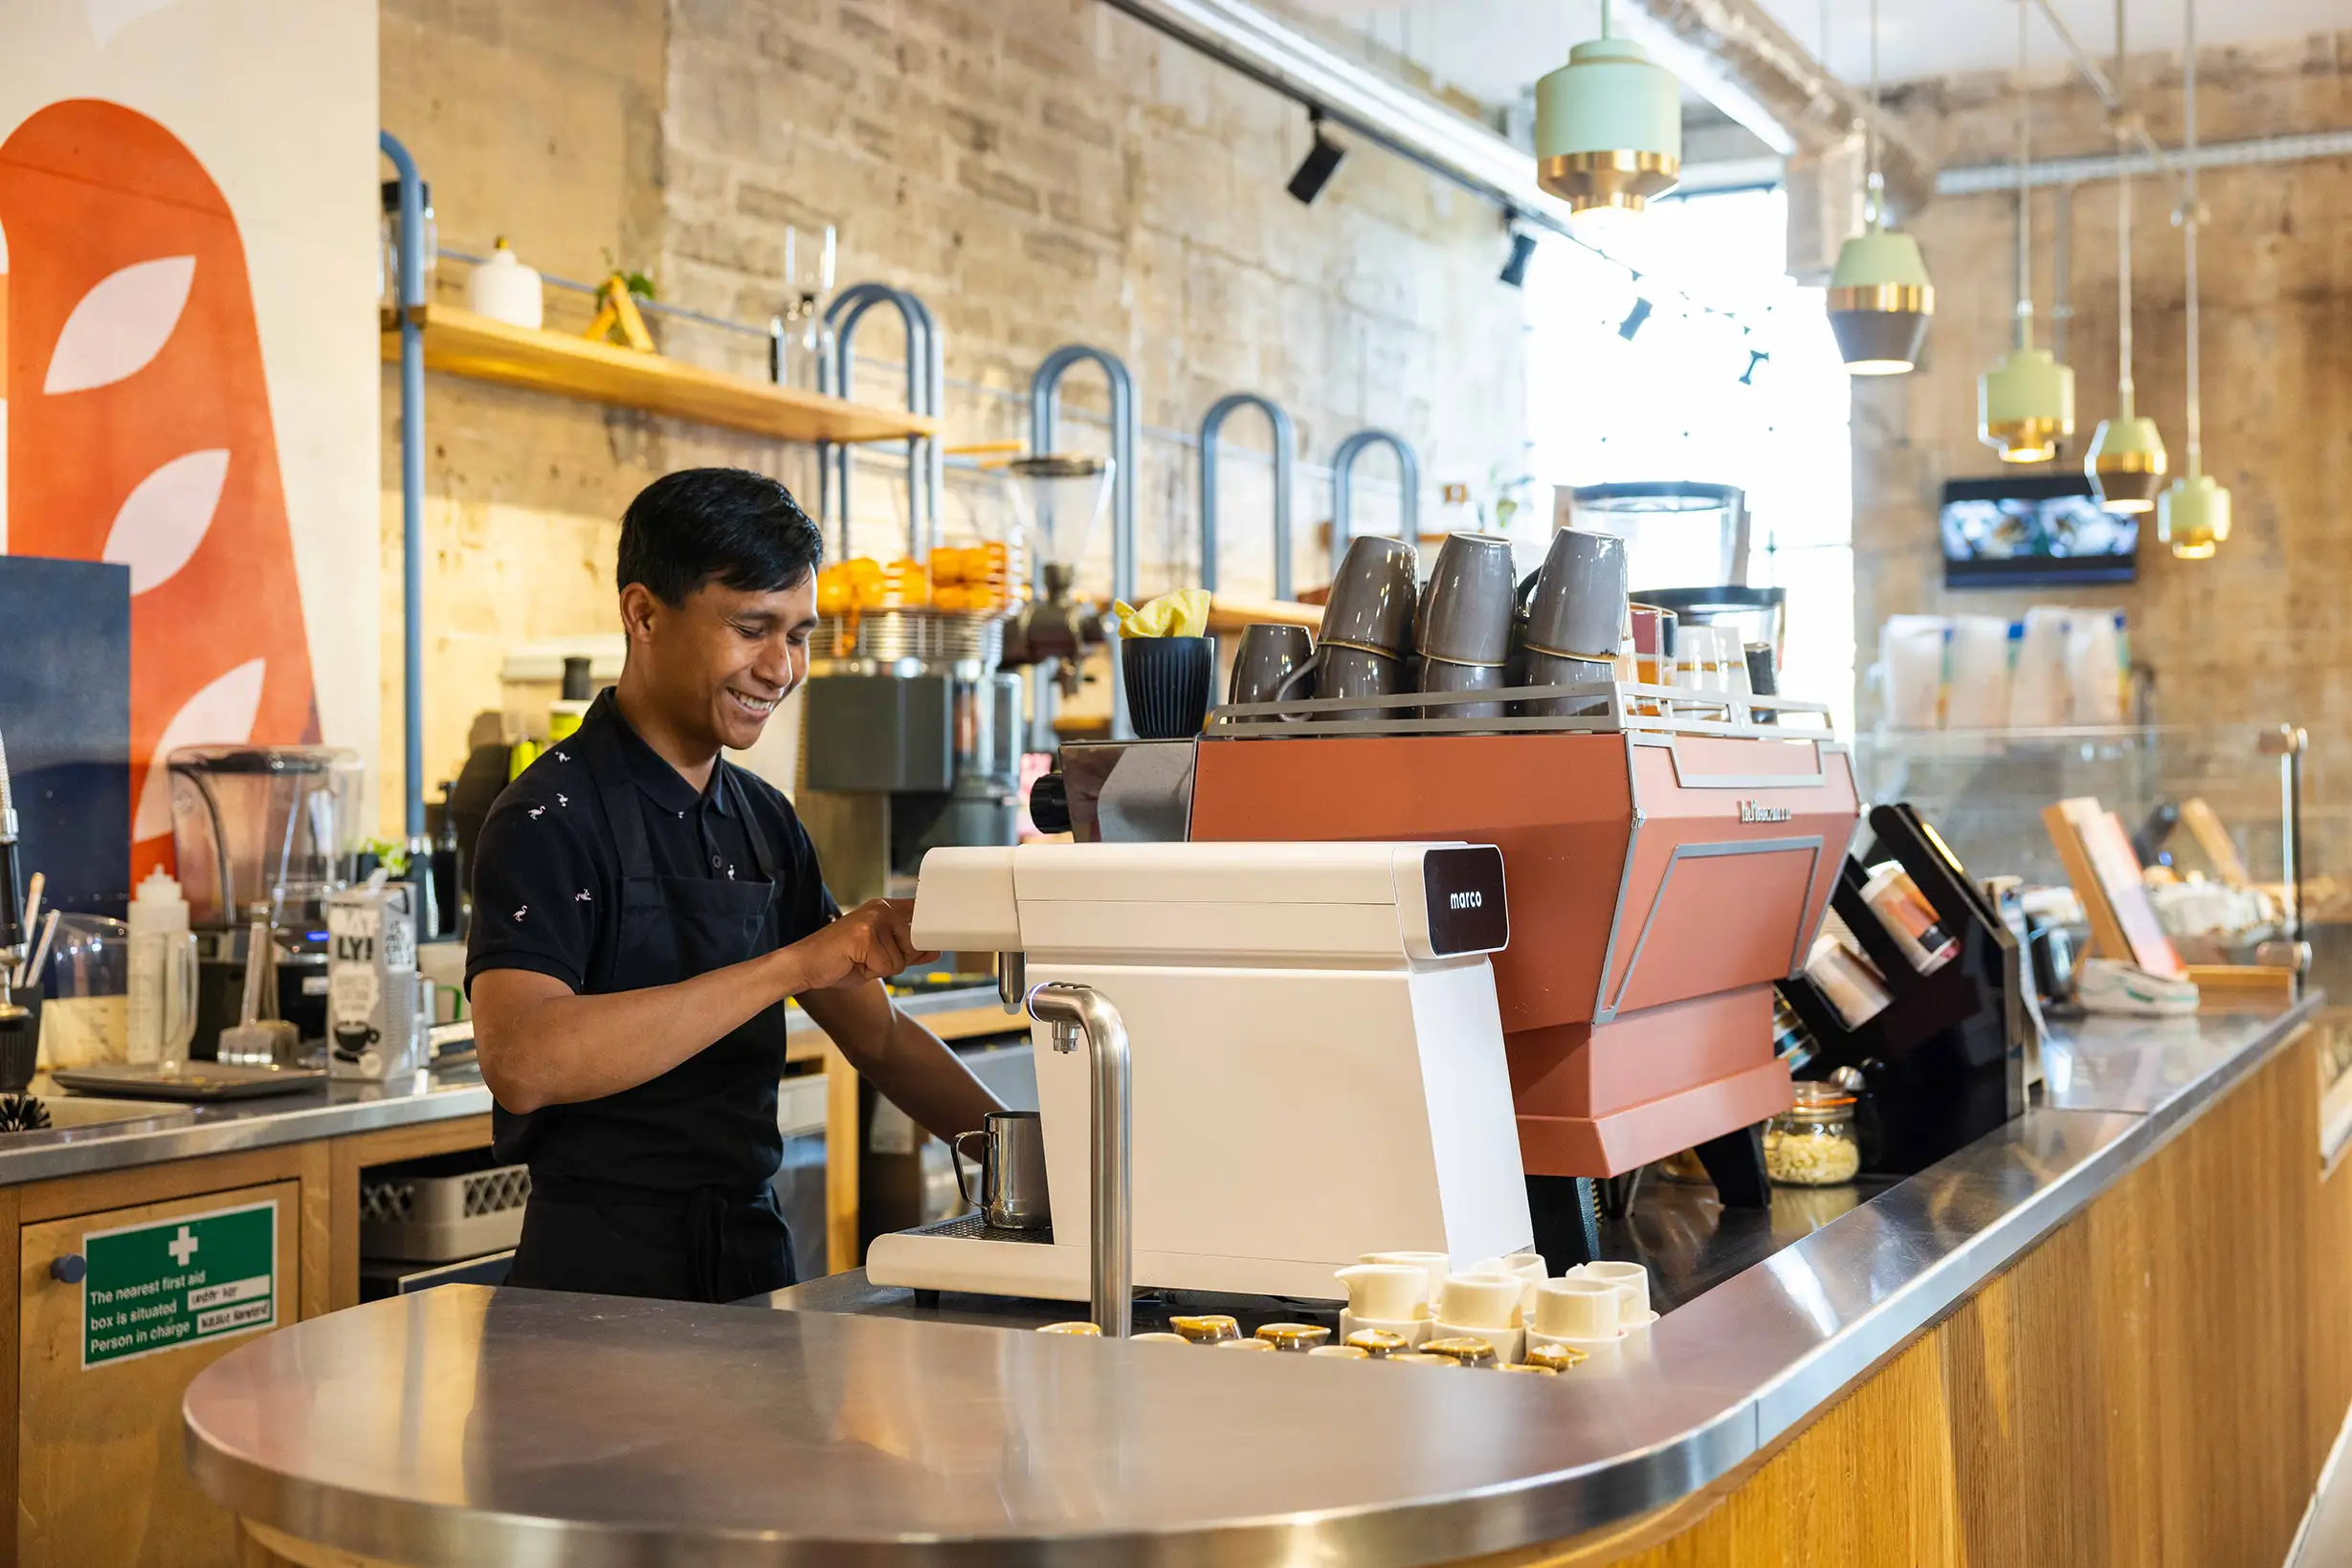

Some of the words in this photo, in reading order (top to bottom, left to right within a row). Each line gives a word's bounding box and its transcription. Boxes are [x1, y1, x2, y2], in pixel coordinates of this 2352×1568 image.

[1451, 891, 1482, 910] marco
[338, 936, 373, 961] LY!
[90, 1291, 113, 1306] The
[116, 1280, 160, 1301] nearest
[162, 1274, 186, 1292] first
[188, 1270, 206, 1287] aid
[91, 1316, 113, 1332] box
[116, 1312, 128, 1326] is
[130, 1298, 177, 1323] situated
[91, 1334, 133, 1354] Person
[136, 1329, 147, 1344] in
[149, 1321, 190, 1338] charge
